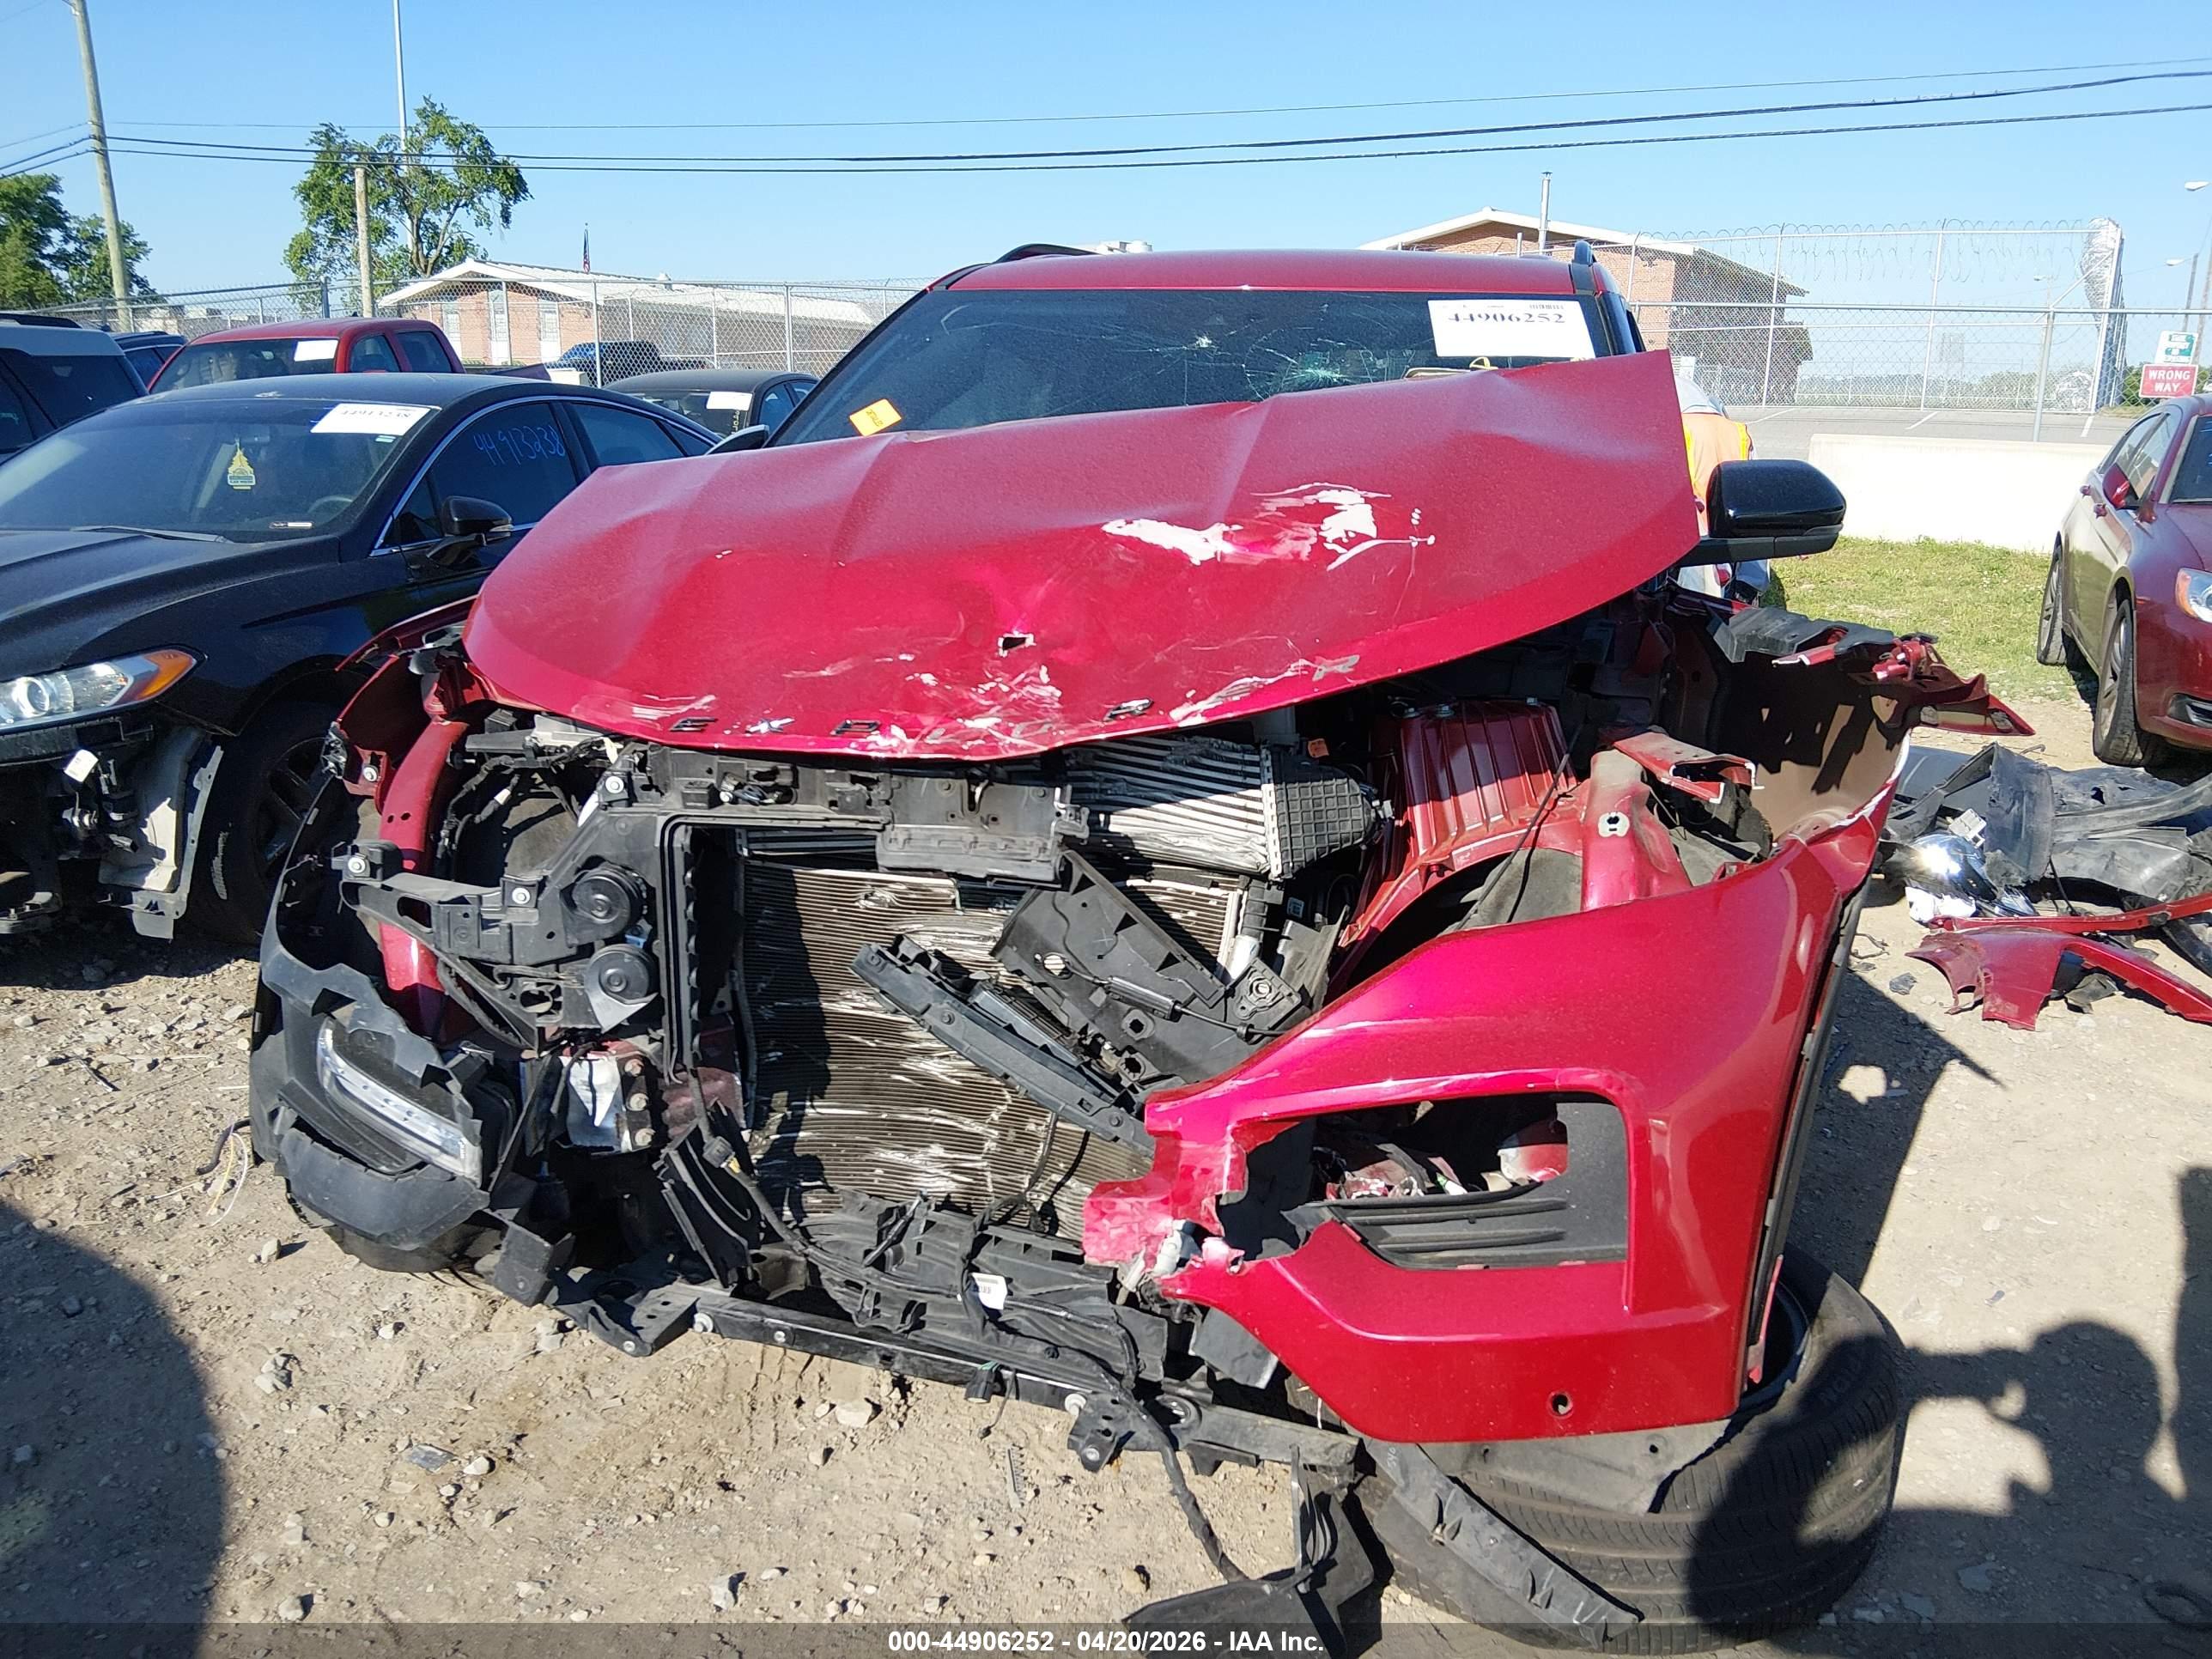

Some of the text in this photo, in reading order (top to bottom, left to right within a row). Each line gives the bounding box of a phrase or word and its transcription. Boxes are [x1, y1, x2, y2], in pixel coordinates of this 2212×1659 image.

[1449, 313, 1565, 324] 44906252
[2148, 369, 2191, 380] WRONG
[2154, 382, 2181, 392] WAY
